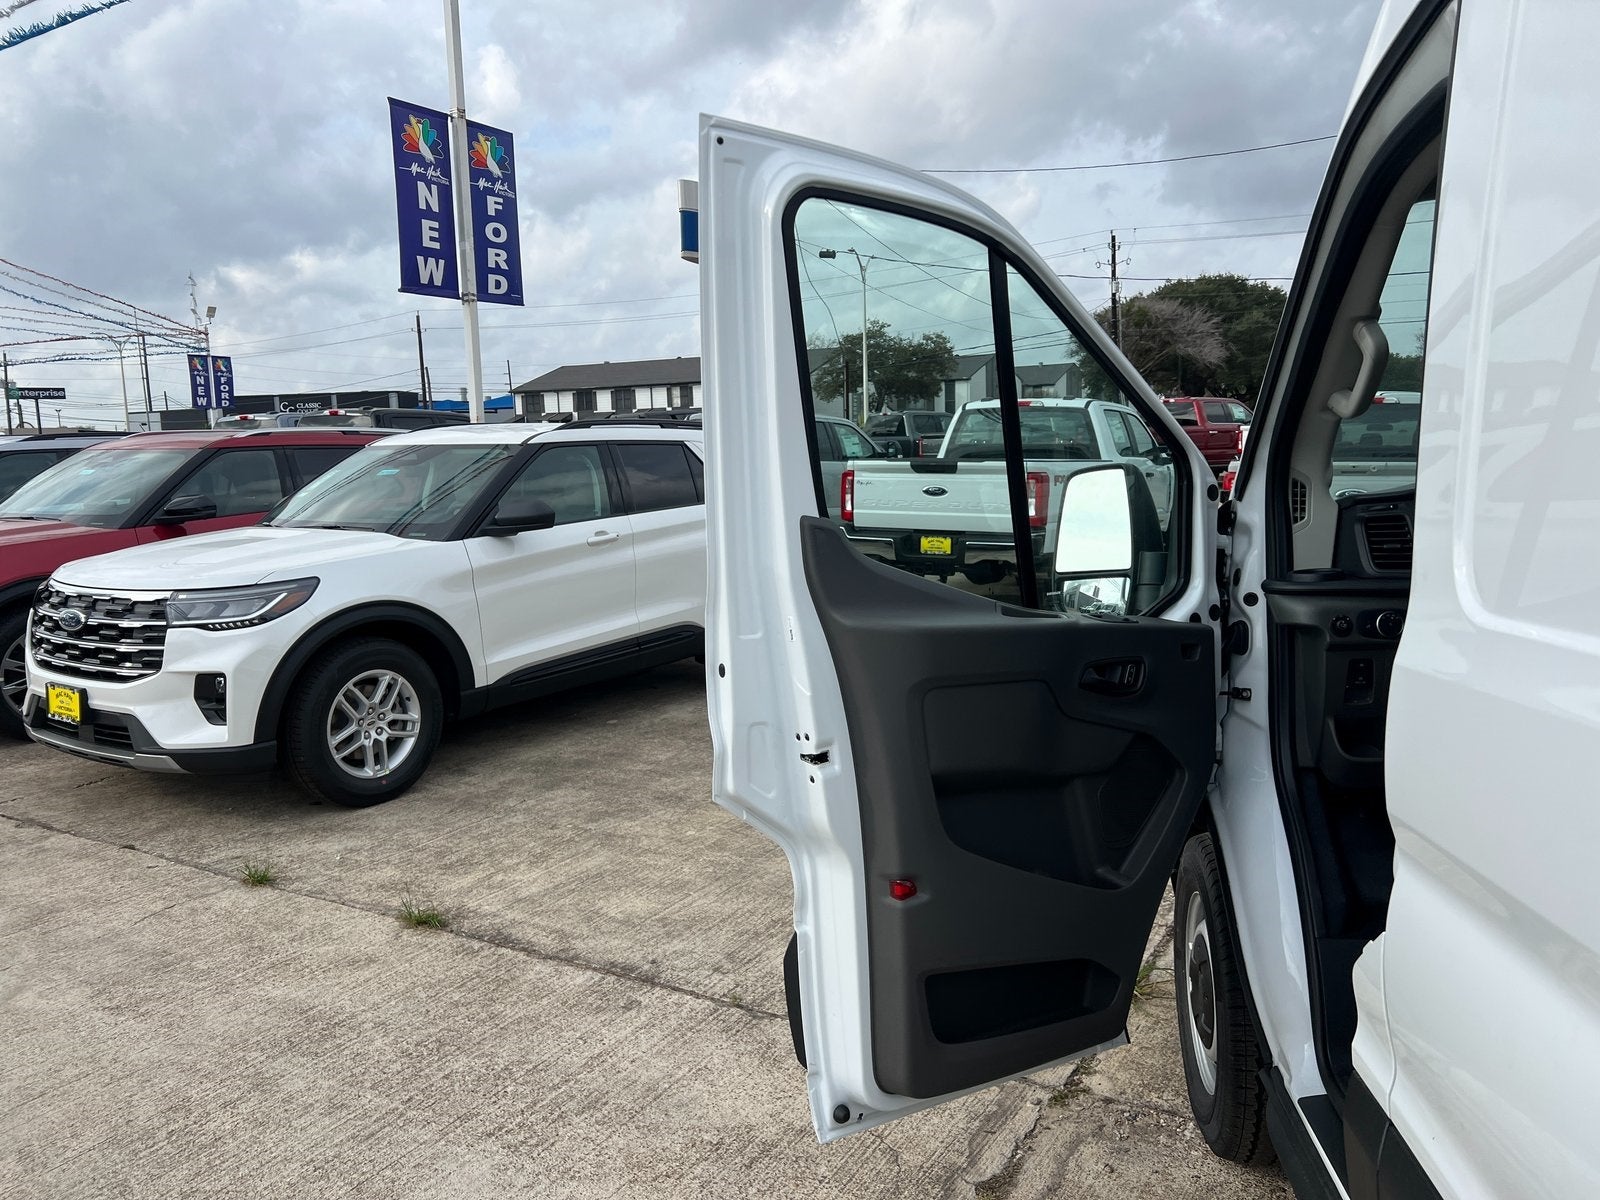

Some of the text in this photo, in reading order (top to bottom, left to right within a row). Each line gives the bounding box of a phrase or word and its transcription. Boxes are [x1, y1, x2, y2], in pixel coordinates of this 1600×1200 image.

[416, 181, 446, 287] NEW
[484, 195, 509, 295] FORD
[196, 376, 207, 406] NEW
[220, 377, 230, 407] FORD
